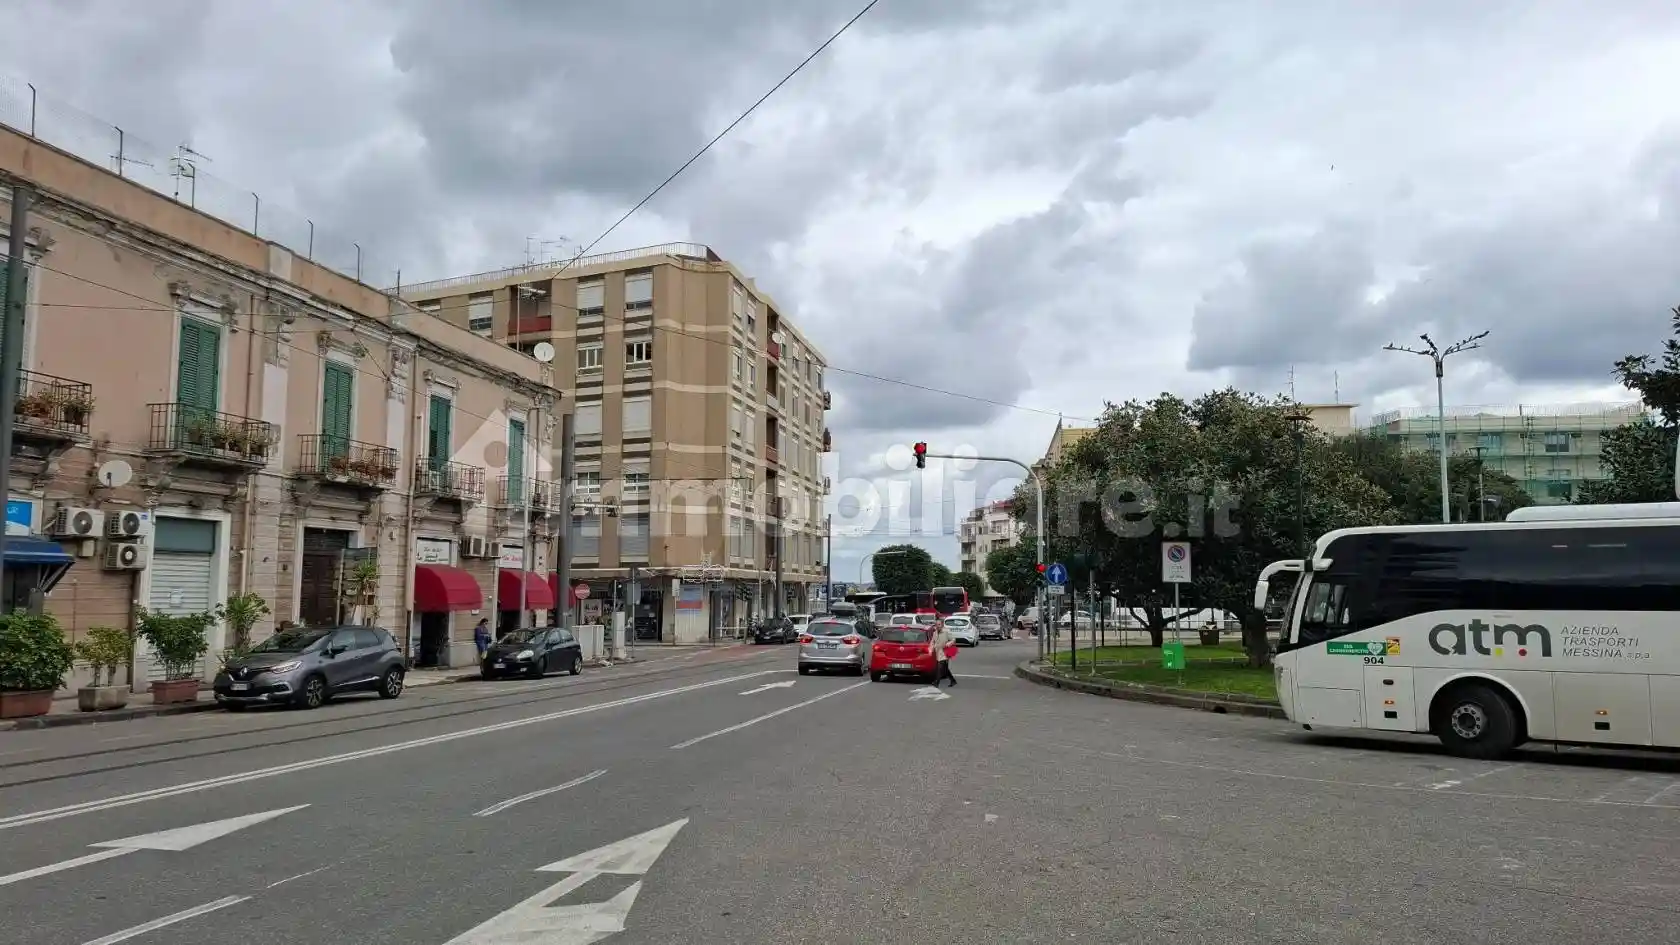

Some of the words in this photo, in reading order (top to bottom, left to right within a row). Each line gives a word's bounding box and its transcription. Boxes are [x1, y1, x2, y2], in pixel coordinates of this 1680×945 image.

[1560, 625, 1620, 636] AZIENDA
[1428, 618, 1552, 658] atm
[1562, 636, 1639, 647] TRASPORTI
[1562, 647, 1623, 658] MESSINA
[1363, 656, 1385, 665] 904
